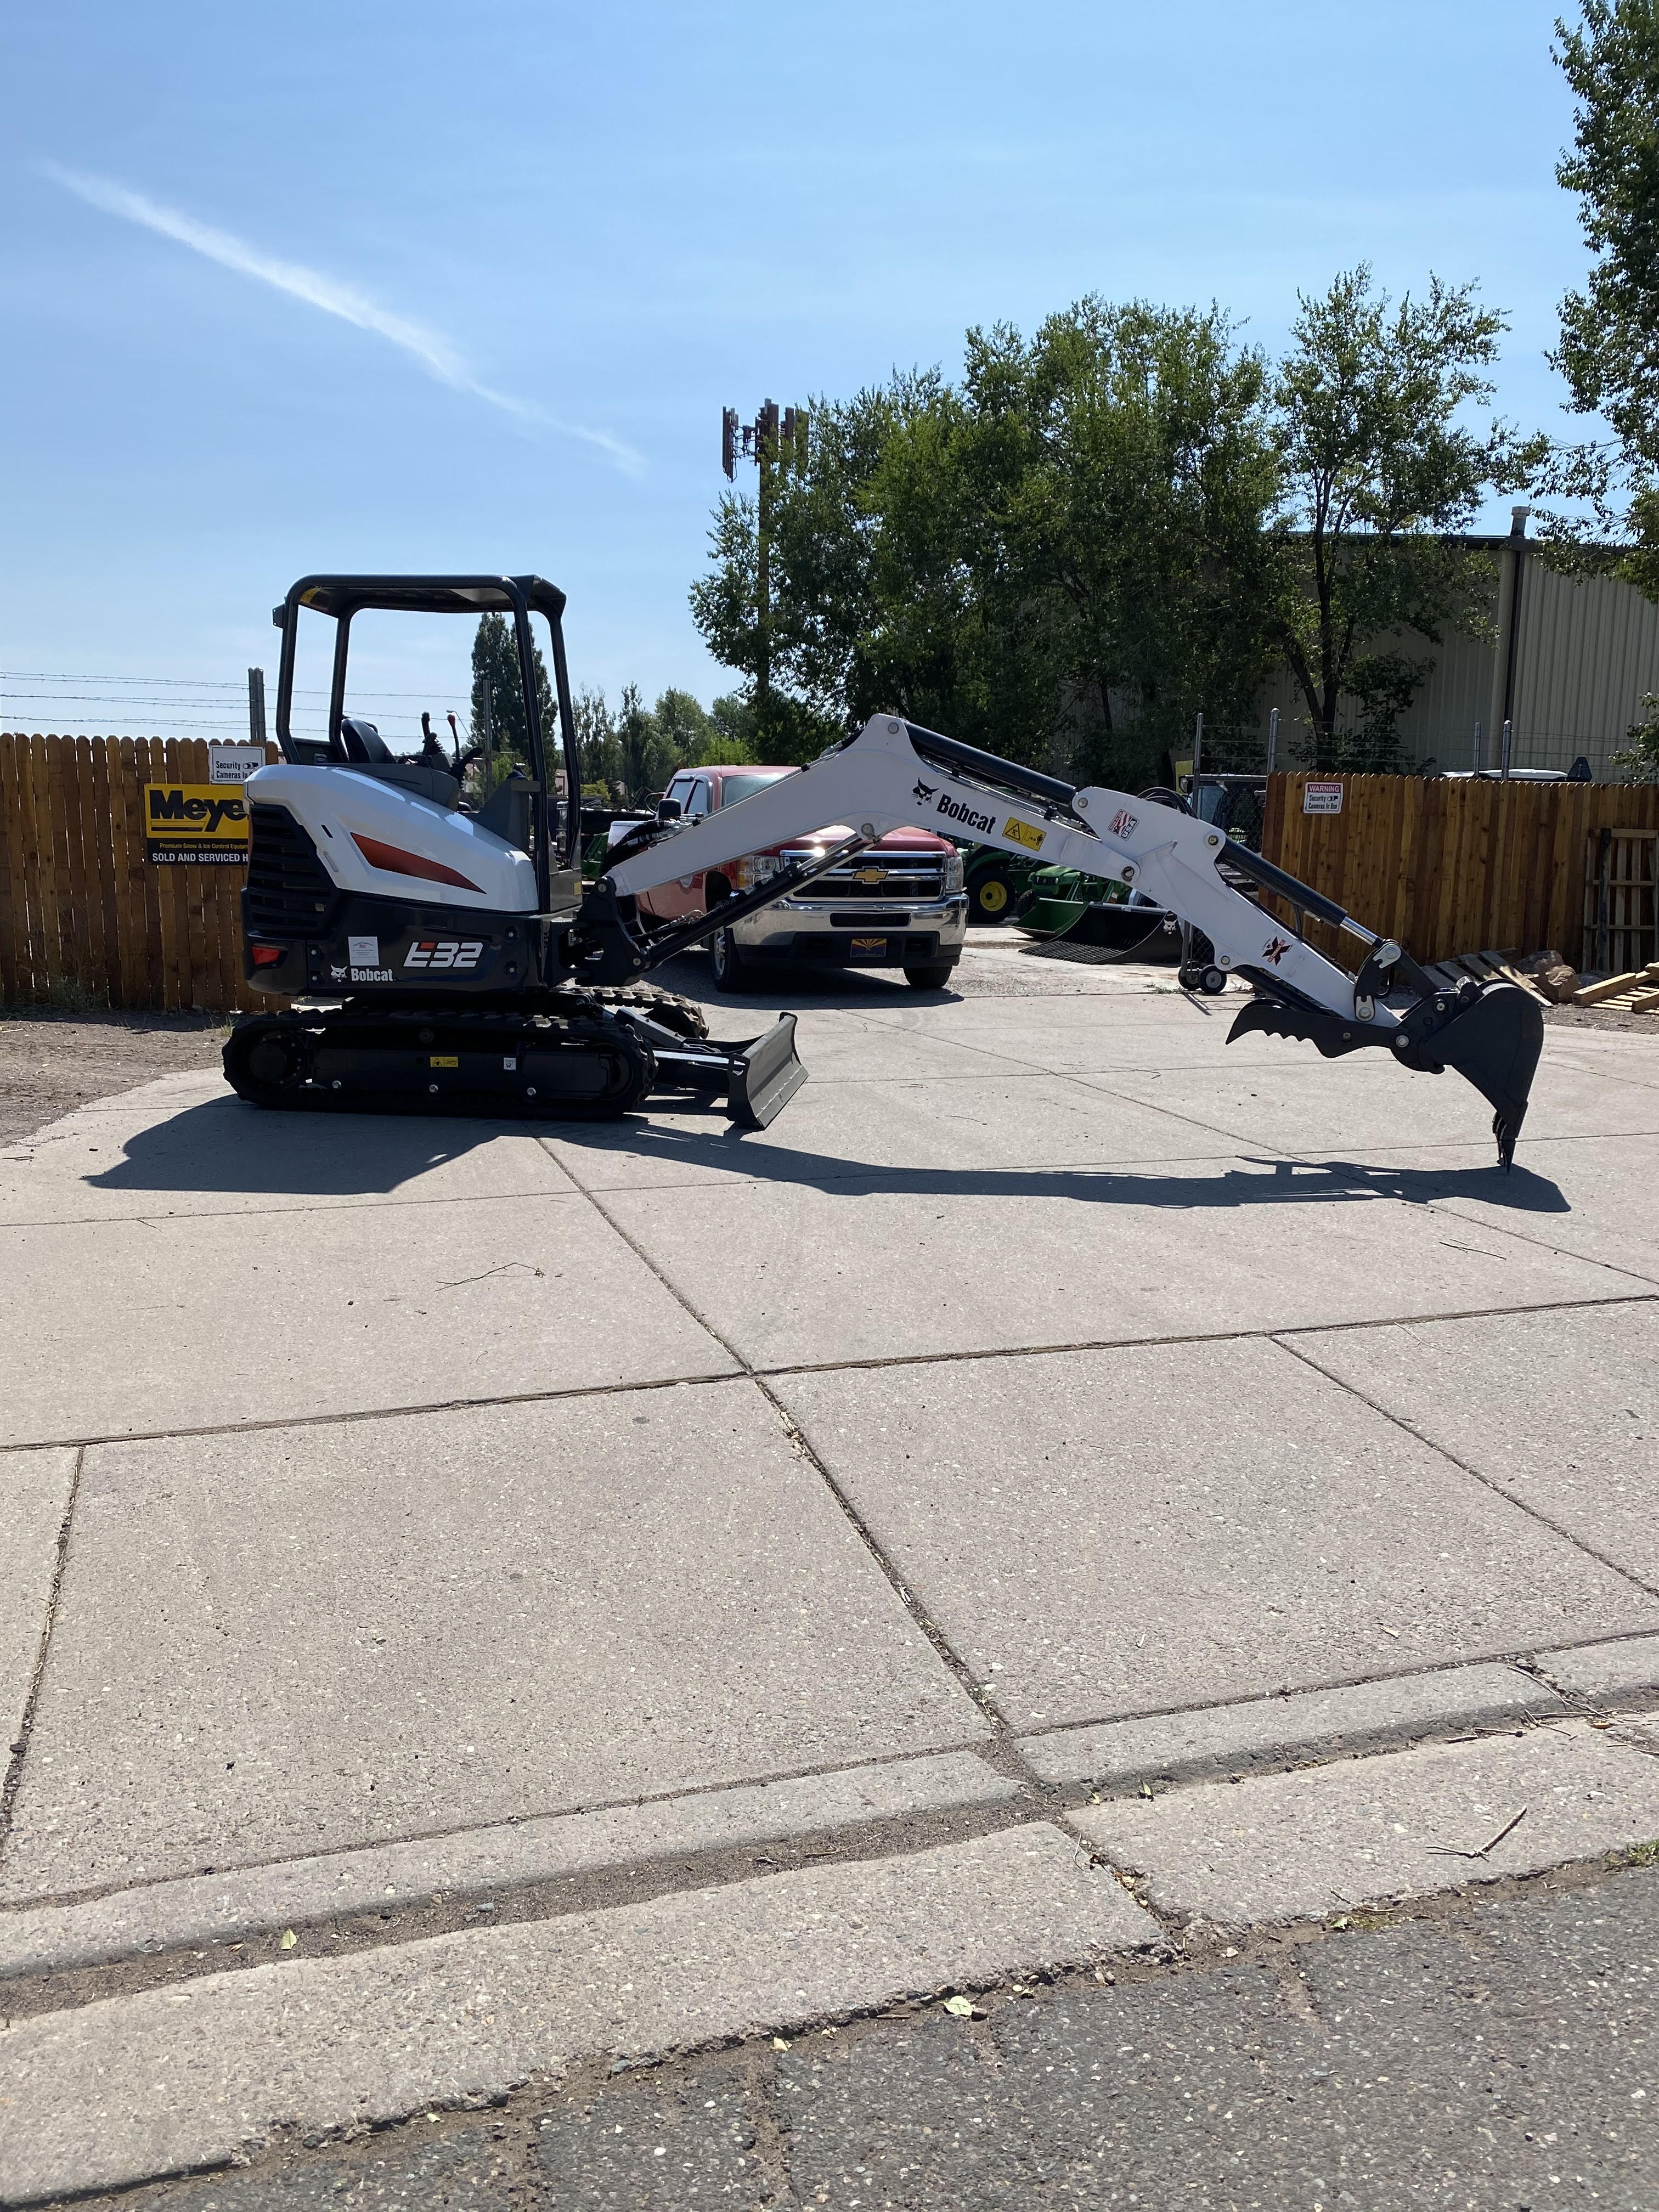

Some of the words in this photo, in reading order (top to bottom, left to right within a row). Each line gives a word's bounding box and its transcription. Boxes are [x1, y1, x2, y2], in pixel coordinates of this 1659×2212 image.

[216, 761, 240, 770] Security
[149, 790, 249, 832] Meye
[936, 794, 996, 834] Bobcat
[1121, 820, 1136, 838] USA
[153, 853, 175, 861] SOLD
[178, 853, 196, 861] AND
[198, 853, 240, 862] SERVICED
[403, 942, 483, 967] E32
[351, 968, 393, 981] Bobcat
